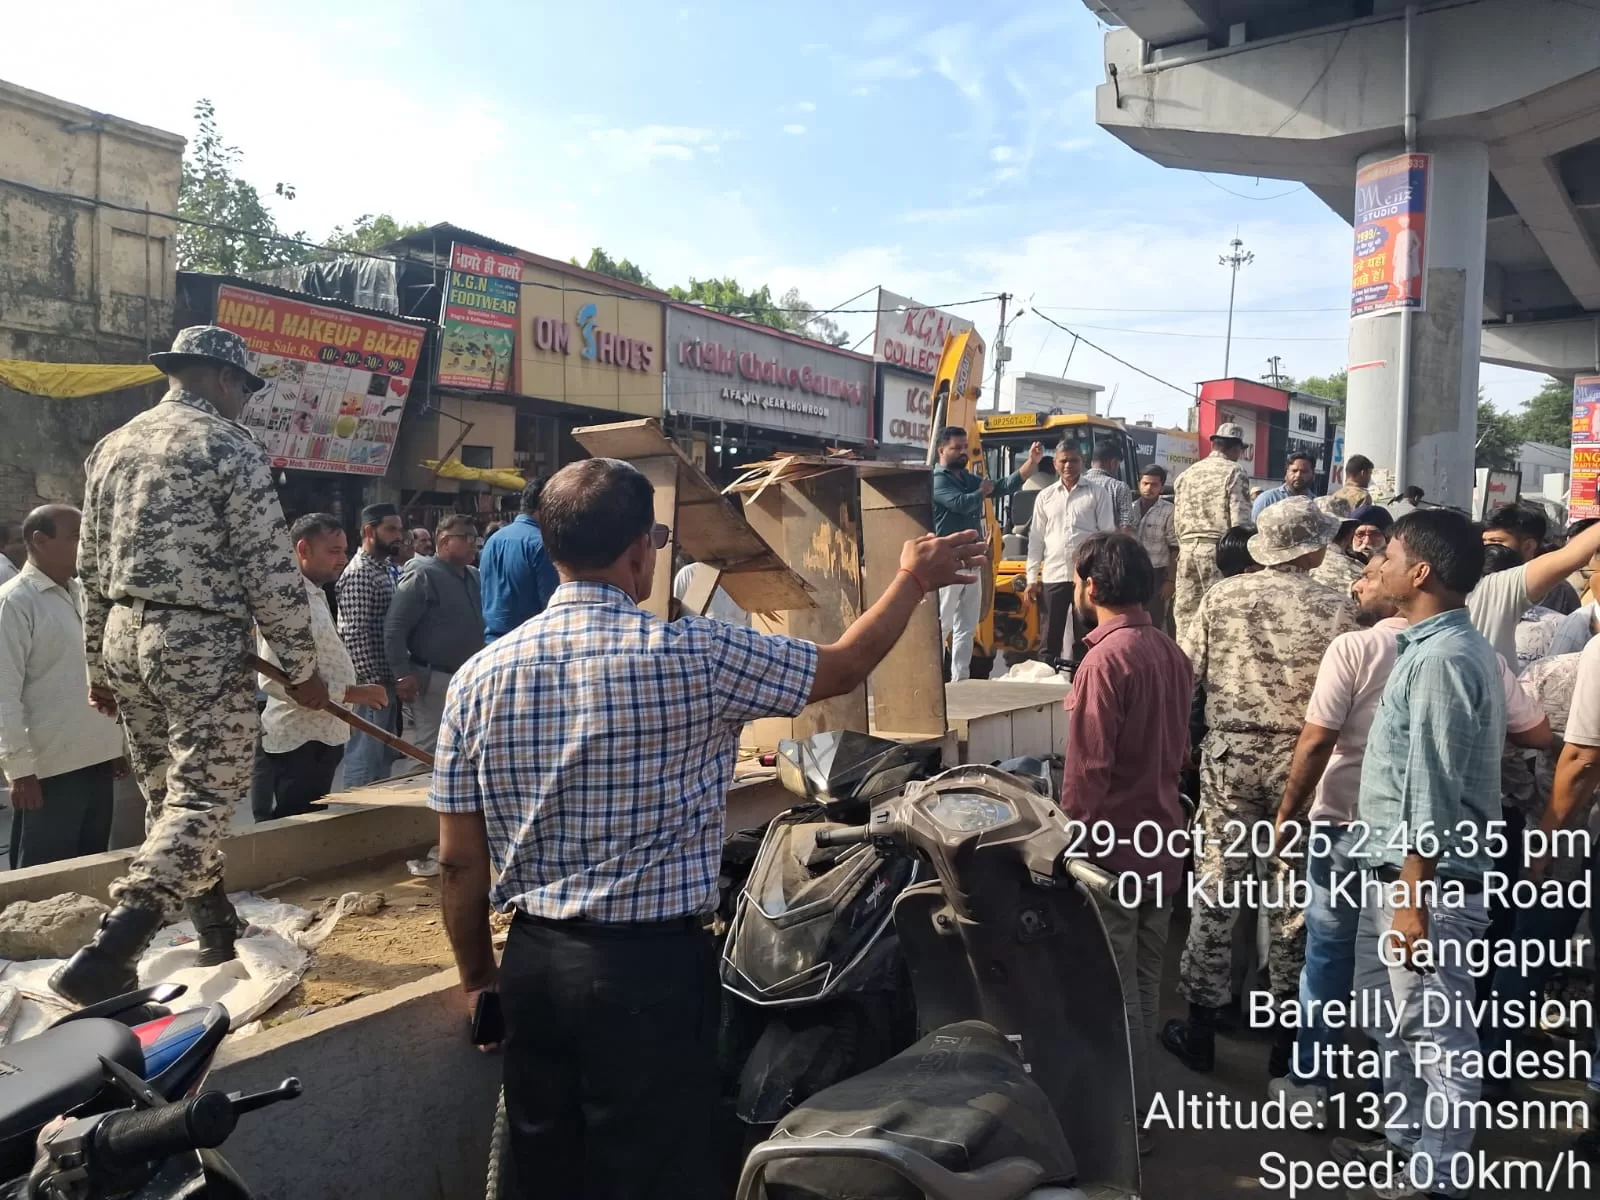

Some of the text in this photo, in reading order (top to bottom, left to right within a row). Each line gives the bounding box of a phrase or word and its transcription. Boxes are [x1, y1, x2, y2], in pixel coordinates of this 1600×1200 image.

[1362, 206, 1398, 223] STUDIO
[452, 271, 488, 292] K.G.N
[450, 289, 517, 314] FOOTWEAR
[218, 301, 420, 361] INDIA MAKEUP BAZAR
[532, 303, 654, 373] OM SHOES
[273, 338, 298, 356] Sale
[300, 344, 316, 360] Rs.
[321, 347, 339, 361] 10/-
[343, 351, 361, 366] 20/-
[366, 354, 384, 369] 30/-
[387, 359, 404, 373] 99/-
[785, 398, 830, 417] SHOWROOM
